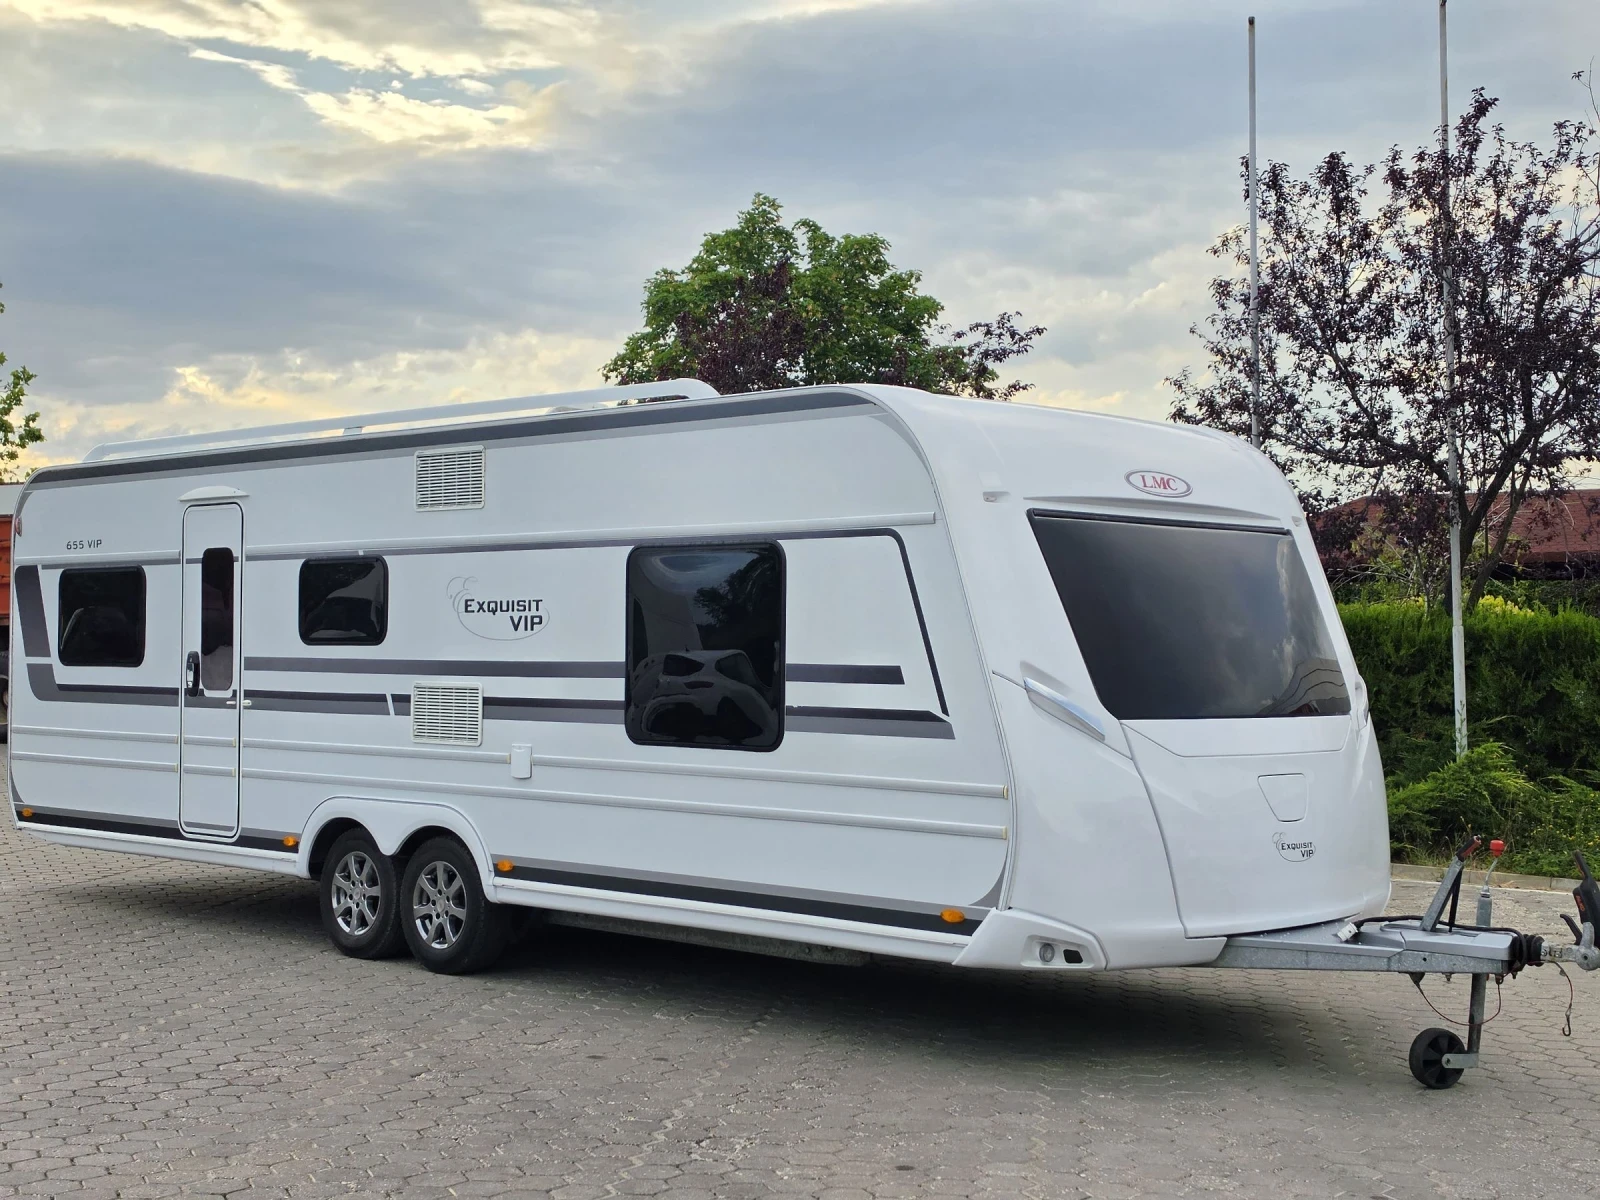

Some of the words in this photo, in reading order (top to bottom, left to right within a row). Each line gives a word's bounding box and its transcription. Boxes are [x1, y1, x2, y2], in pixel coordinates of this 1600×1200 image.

[1140, 474, 1178, 491] LMC
[66, 540, 84, 550] 655
[87, 539, 102, 549] VIP
[509, 614, 543, 632] VIP
[1300, 849, 1314, 858] VIP
